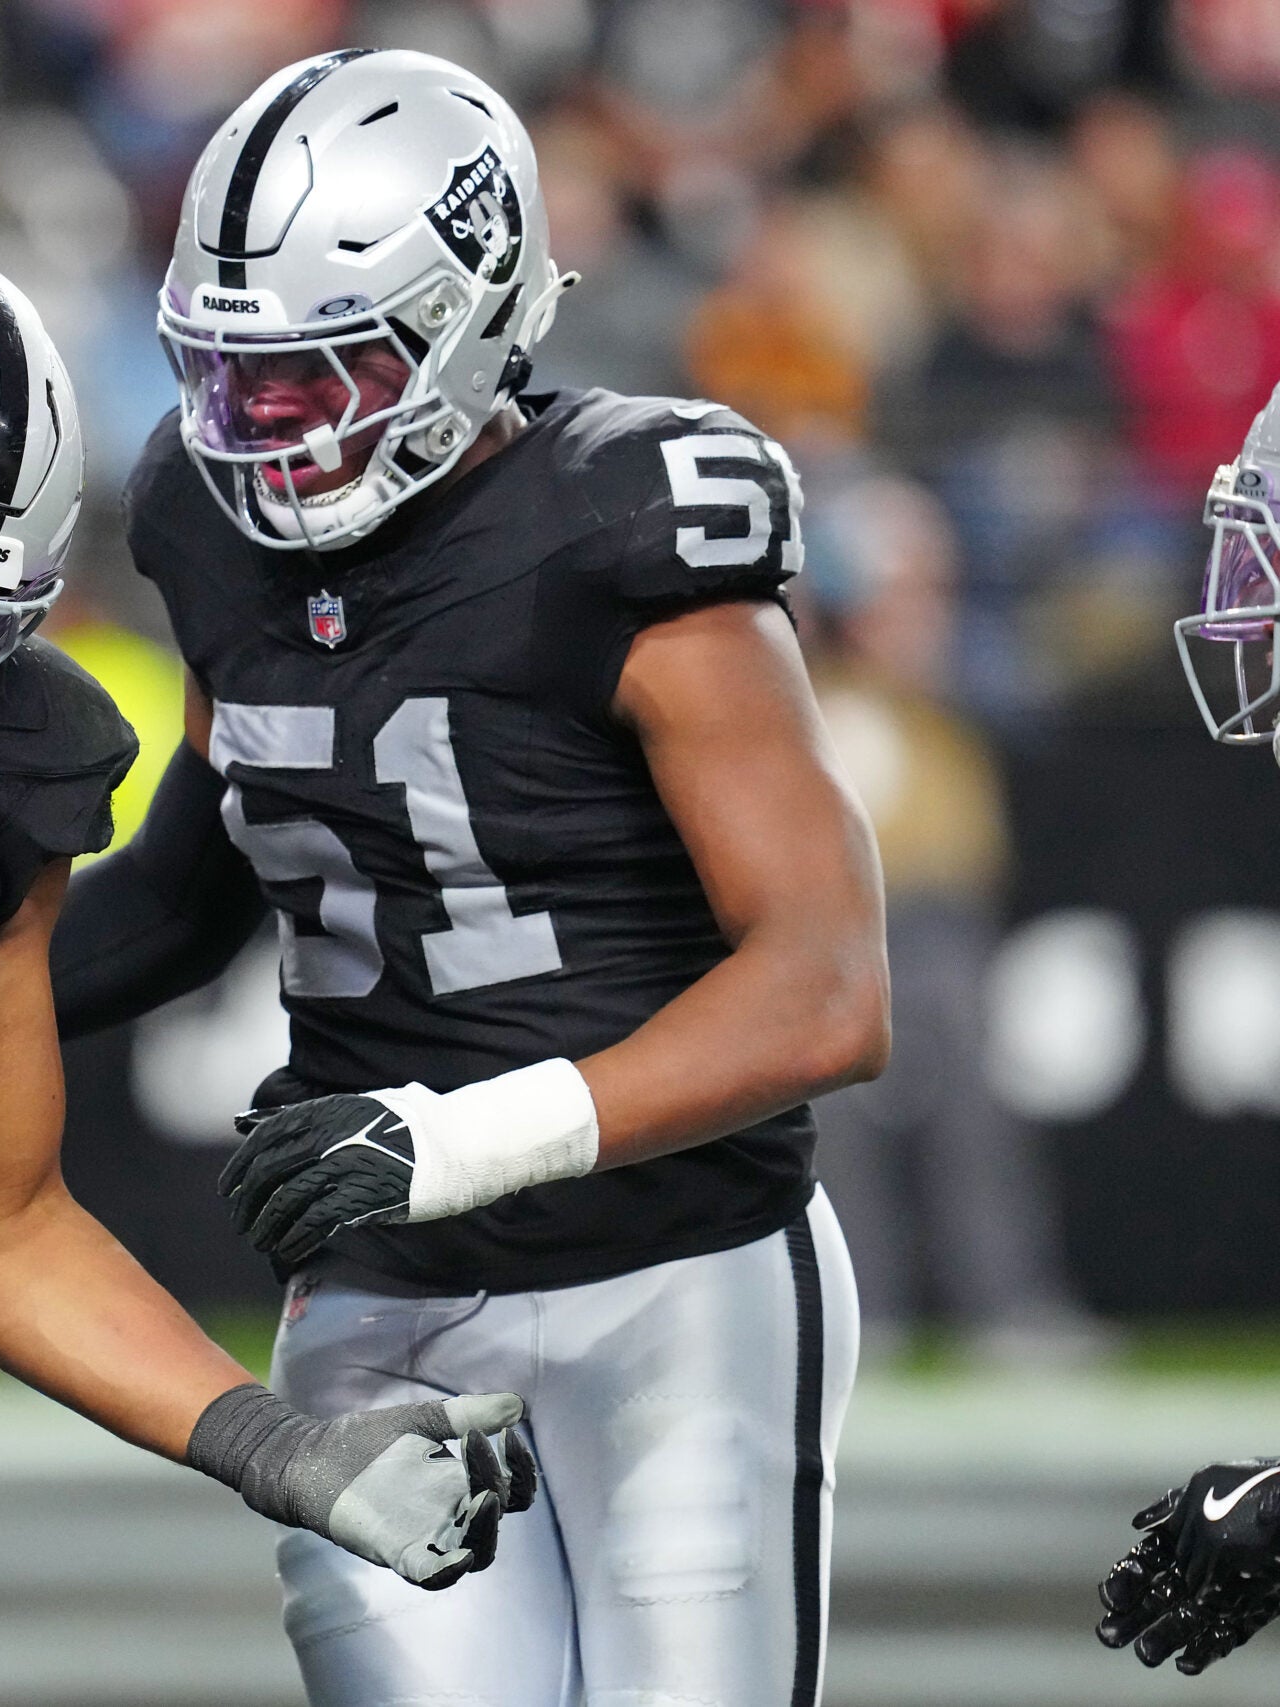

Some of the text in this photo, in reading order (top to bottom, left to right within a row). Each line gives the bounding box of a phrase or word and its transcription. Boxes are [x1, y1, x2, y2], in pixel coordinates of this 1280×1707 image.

[434, 153, 495, 220] RAIDERS
[202, 295, 260, 314] RAIDERS
[209, 697, 562, 998] 51
